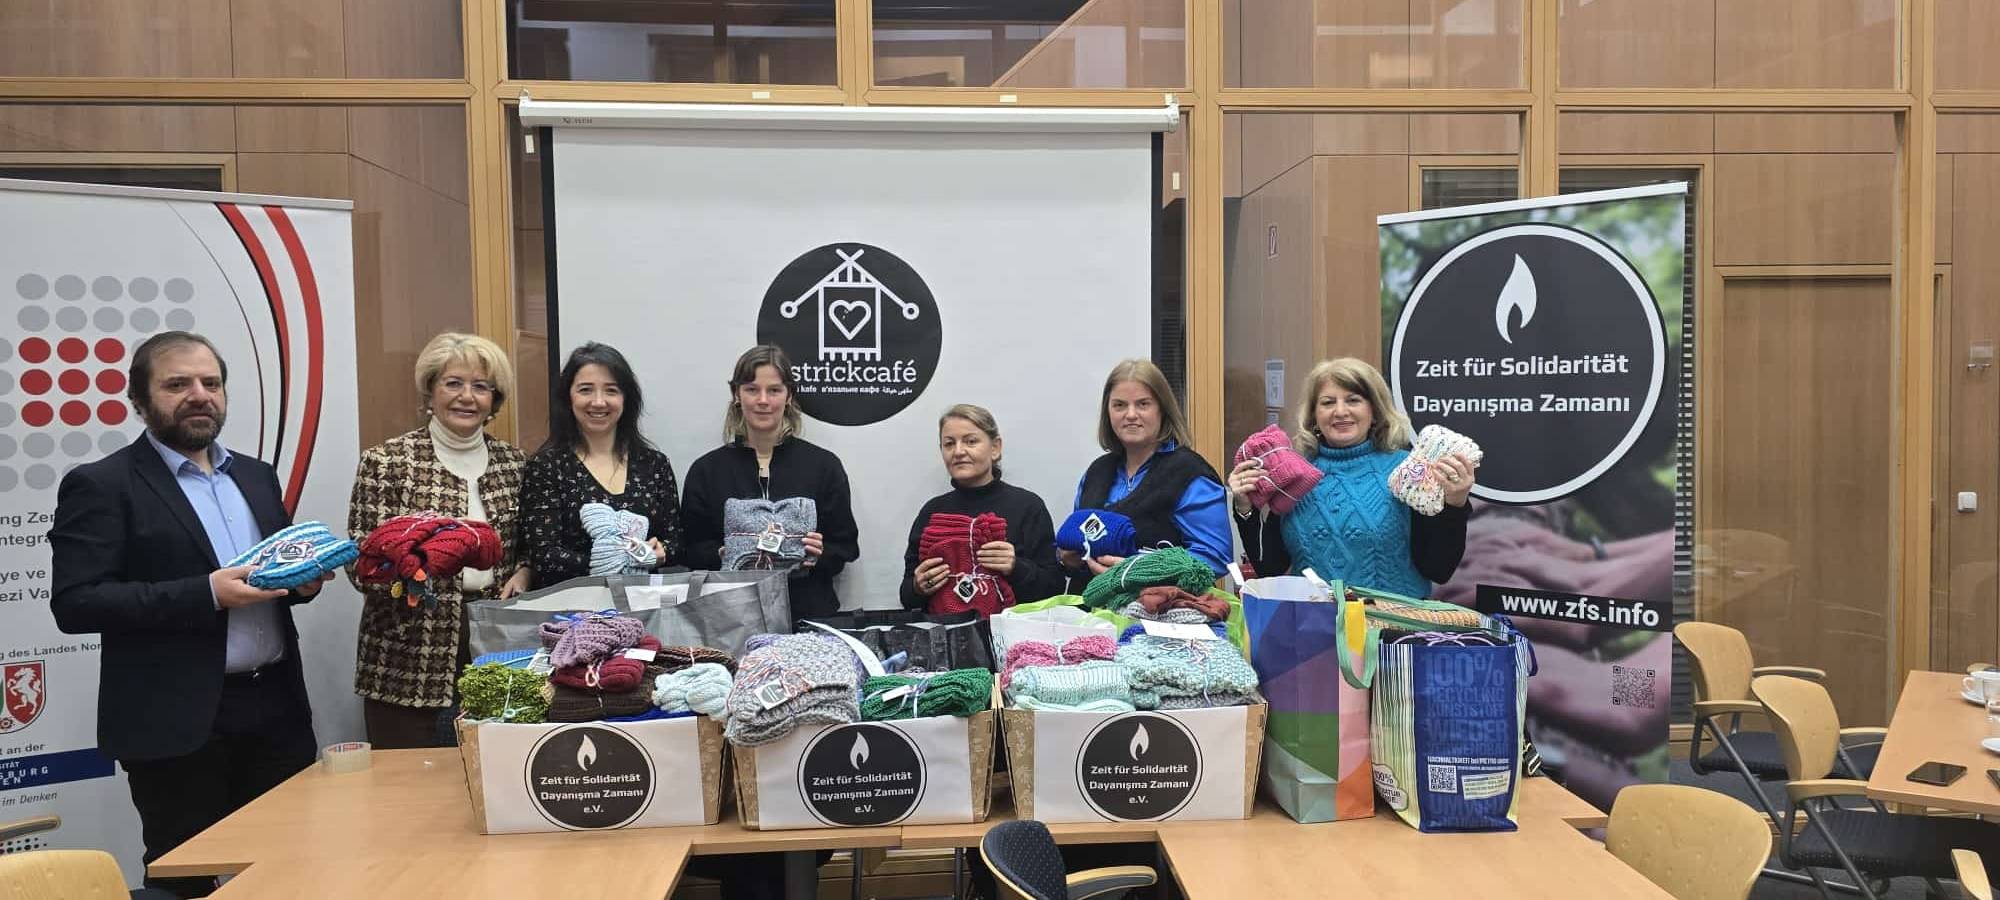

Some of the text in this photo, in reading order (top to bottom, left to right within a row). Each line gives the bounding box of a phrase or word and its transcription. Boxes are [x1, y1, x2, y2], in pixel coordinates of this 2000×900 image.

[790, 360, 917, 382] strickcafé
[1416, 353, 1629, 377] Zeit für Solidarität
[1413, 394, 1630, 417] Dayanışma Zamanı
[26, 570, 46, 579] ve
[28, 588, 50, 599] Va
[1502, 594, 1660, 627] www.zfs.info
[8, 649, 30, 658] des
[33, 645, 77, 656] Landes
[1424, 652, 1504, 687] 100%
[25, 743, 46, 752] der
[1090, 764, 1188, 774] Zeit für Solidarität
[540, 774, 641, 785] Zeit für Solidarität
[812, 771, 913, 786] Zeit für Solidarität
[1089, 780, 1189, 791] Dayanışma Zamanı
[2, 792, 57, 806] im Denken
[541, 789, 644, 801] Dayanışma Zamanı
[813, 788, 914, 802] Dayanışma Zamanı
[1128, 795, 1149, 804] e.V.
[583, 805, 605, 813] e.V.
[855, 804, 875, 813] e.V.
